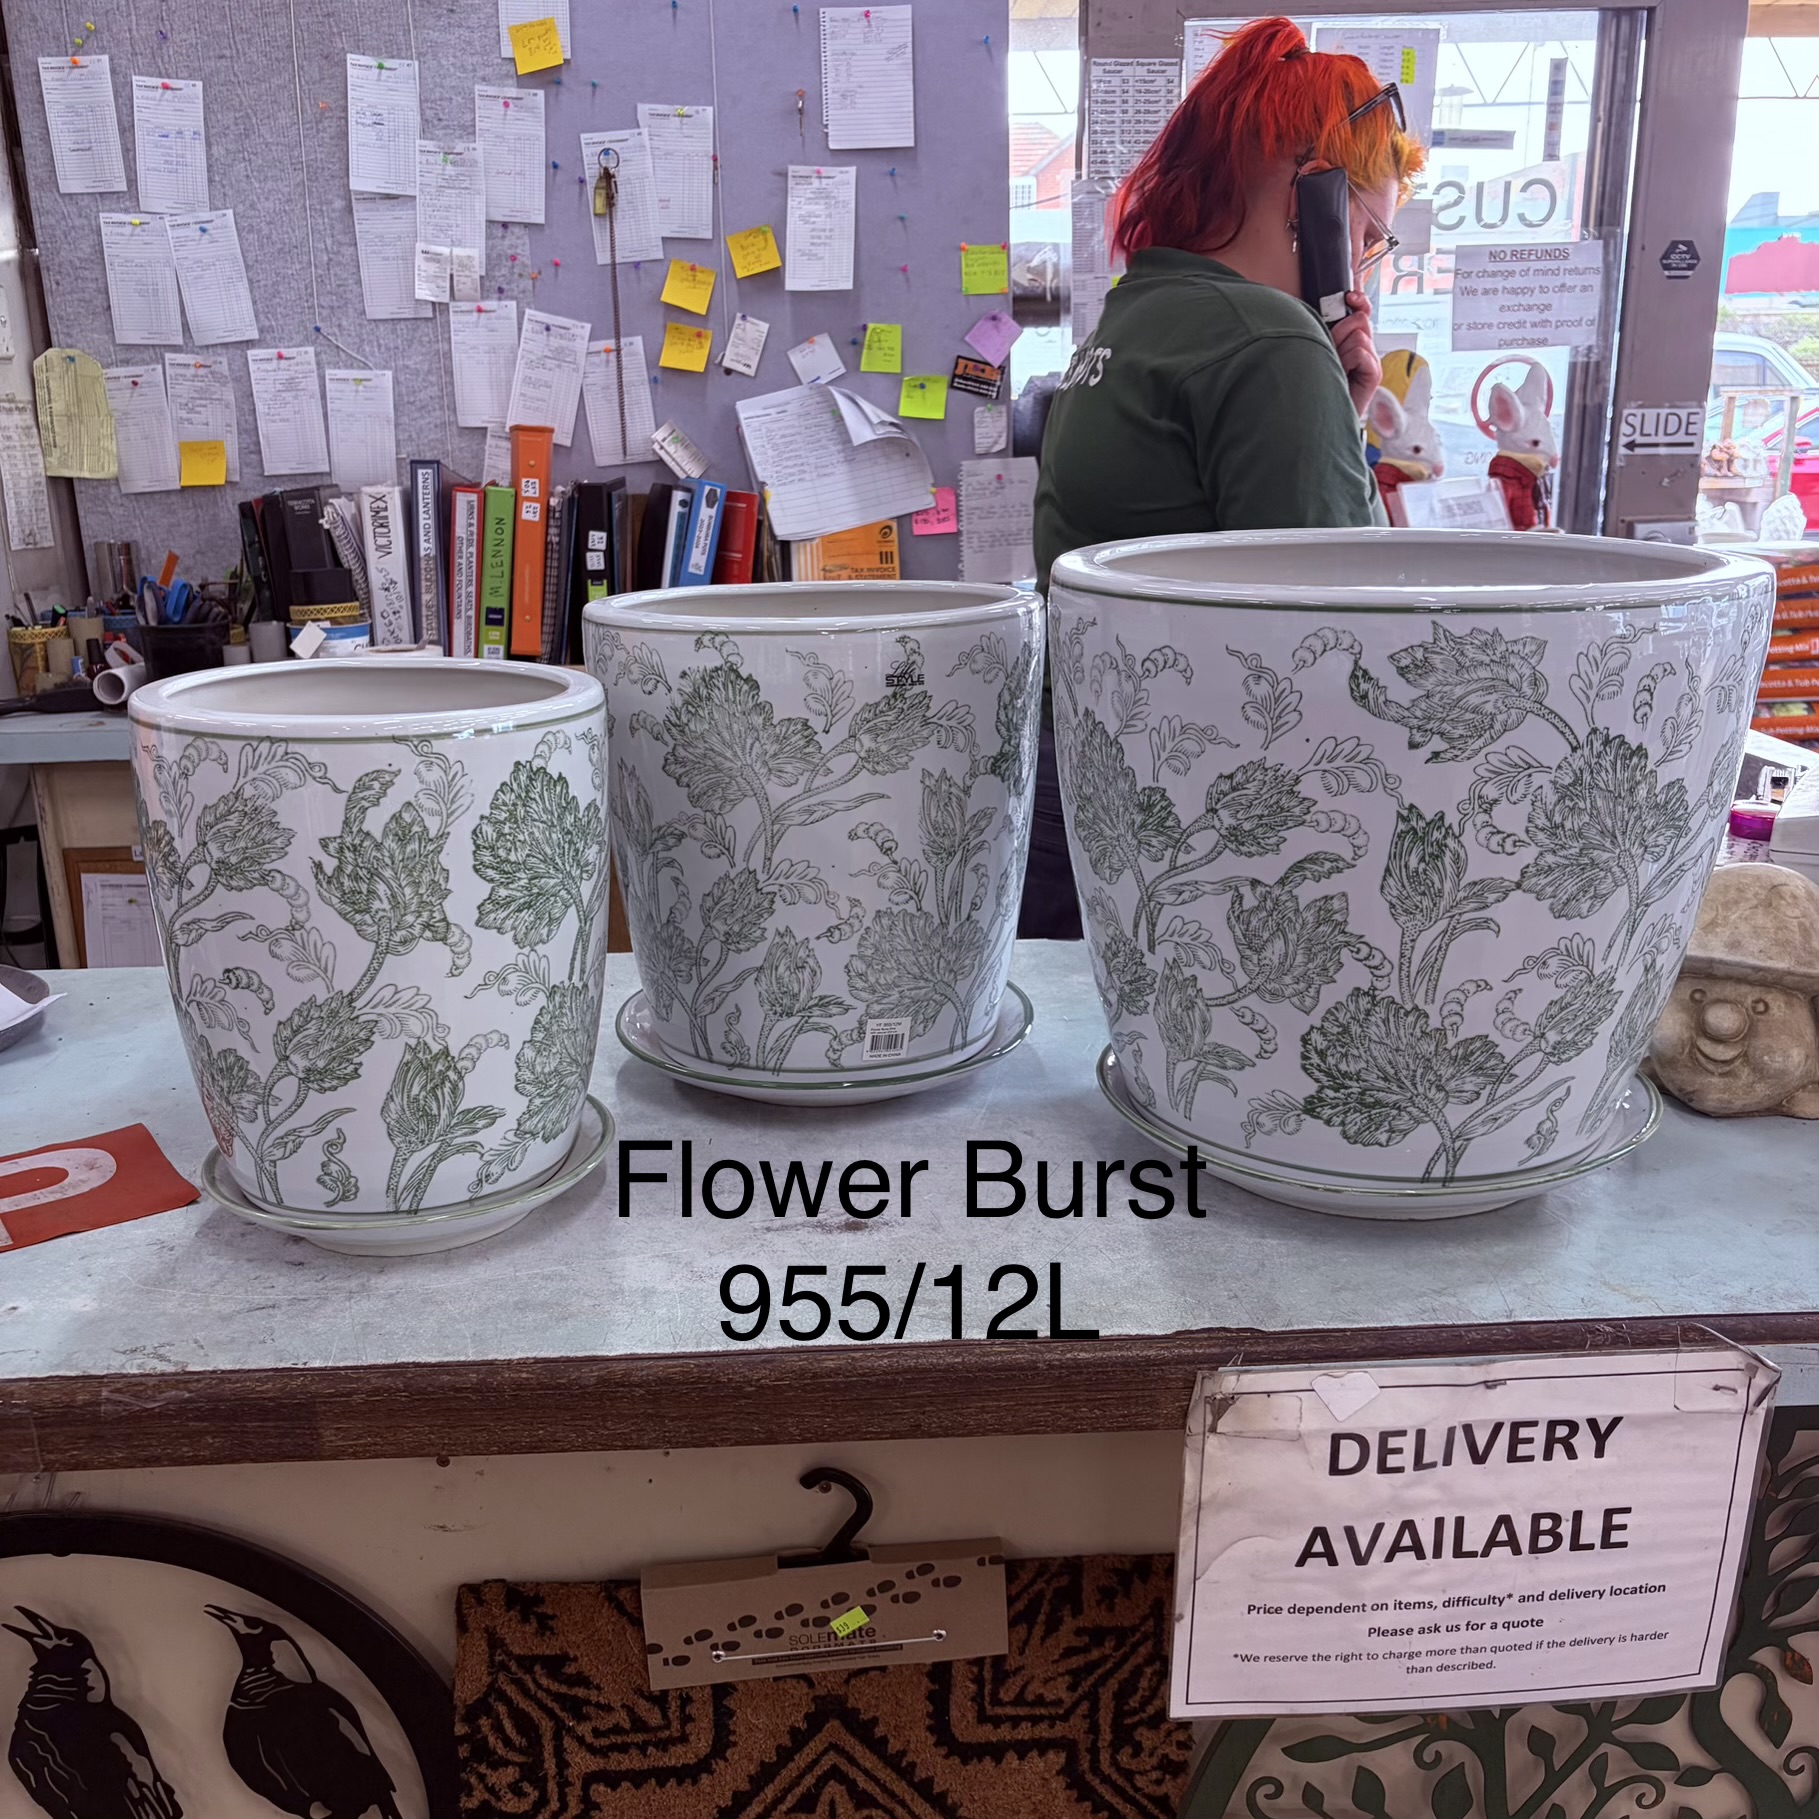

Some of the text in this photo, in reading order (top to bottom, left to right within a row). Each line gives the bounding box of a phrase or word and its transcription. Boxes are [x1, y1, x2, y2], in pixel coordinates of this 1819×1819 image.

[1489, 248, 1570, 261] NO REFUNDS
[1455, 268, 1473, 279] For
[1476, 268, 1516, 280] change
[1519, 267, 1530, 277] of
[1533, 266, 1560, 276] mind
[1459, 283, 1593, 297] We are happy to offer an
[1499, 302, 1552, 314] exchange
[1466, 321, 1493, 330] store
[1497, 320, 1526, 329] credit
[1530, 319, 1552, 328] with
[1555, 317, 1583, 329] proof
[1498, 337, 1549, 348] purchase
[1622, 411, 1699, 437] SLIDE
[421, 471, 431, 520] LANTERNS
[423, 523, 432, 543] AND
[456, 536, 464, 560] OTHER
[423, 547, 434, 594] BUDDHAS
[455, 579, 463, 620] FOUNTAINS
[886, 674, 924, 684] STYLE
[1328, 1415, 1625, 1477] DELIVERY
[1294, 1506, 1633, 1568] AVAILABLE
[1247, 1604, 1283, 1615] Price
[1287, 1602, 1367, 1616] dependent
[1371, 1601, 1389, 1611] on
[1393, 1599, 1438, 1611] items,
[1518, 1591, 1544, 1603] and
[1548, 1587, 1606, 1601] delivery
[1609, 1583, 1666, 1596] location
[836, 1622, 850, 1633] $39
[1367, 1618, 1544, 1638] Please ask us for a quote
[1263, 1653, 1308, 1662] reserve
[1312, 1653, 1331, 1662] the
[1335, 1652, 1363, 1663] right
[1366, 1651, 1379, 1661] to
[1382, 1649, 1422, 1660] charge
[1425, 1647, 1457, 1657] more
[1460, 1644, 1487, 1654] than
[1490, 1641, 1532, 1655] quoted
[1535, 1640, 1544, 1650] if
[1547, 1639, 1566, 1649] the
[1569, 1635, 1615, 1647] delivery
[1618, 1634, 1627, 1643] is
[1630, 1631, 1669, 1642] harder
[1406, 1660, 1496, 1674] than described.
